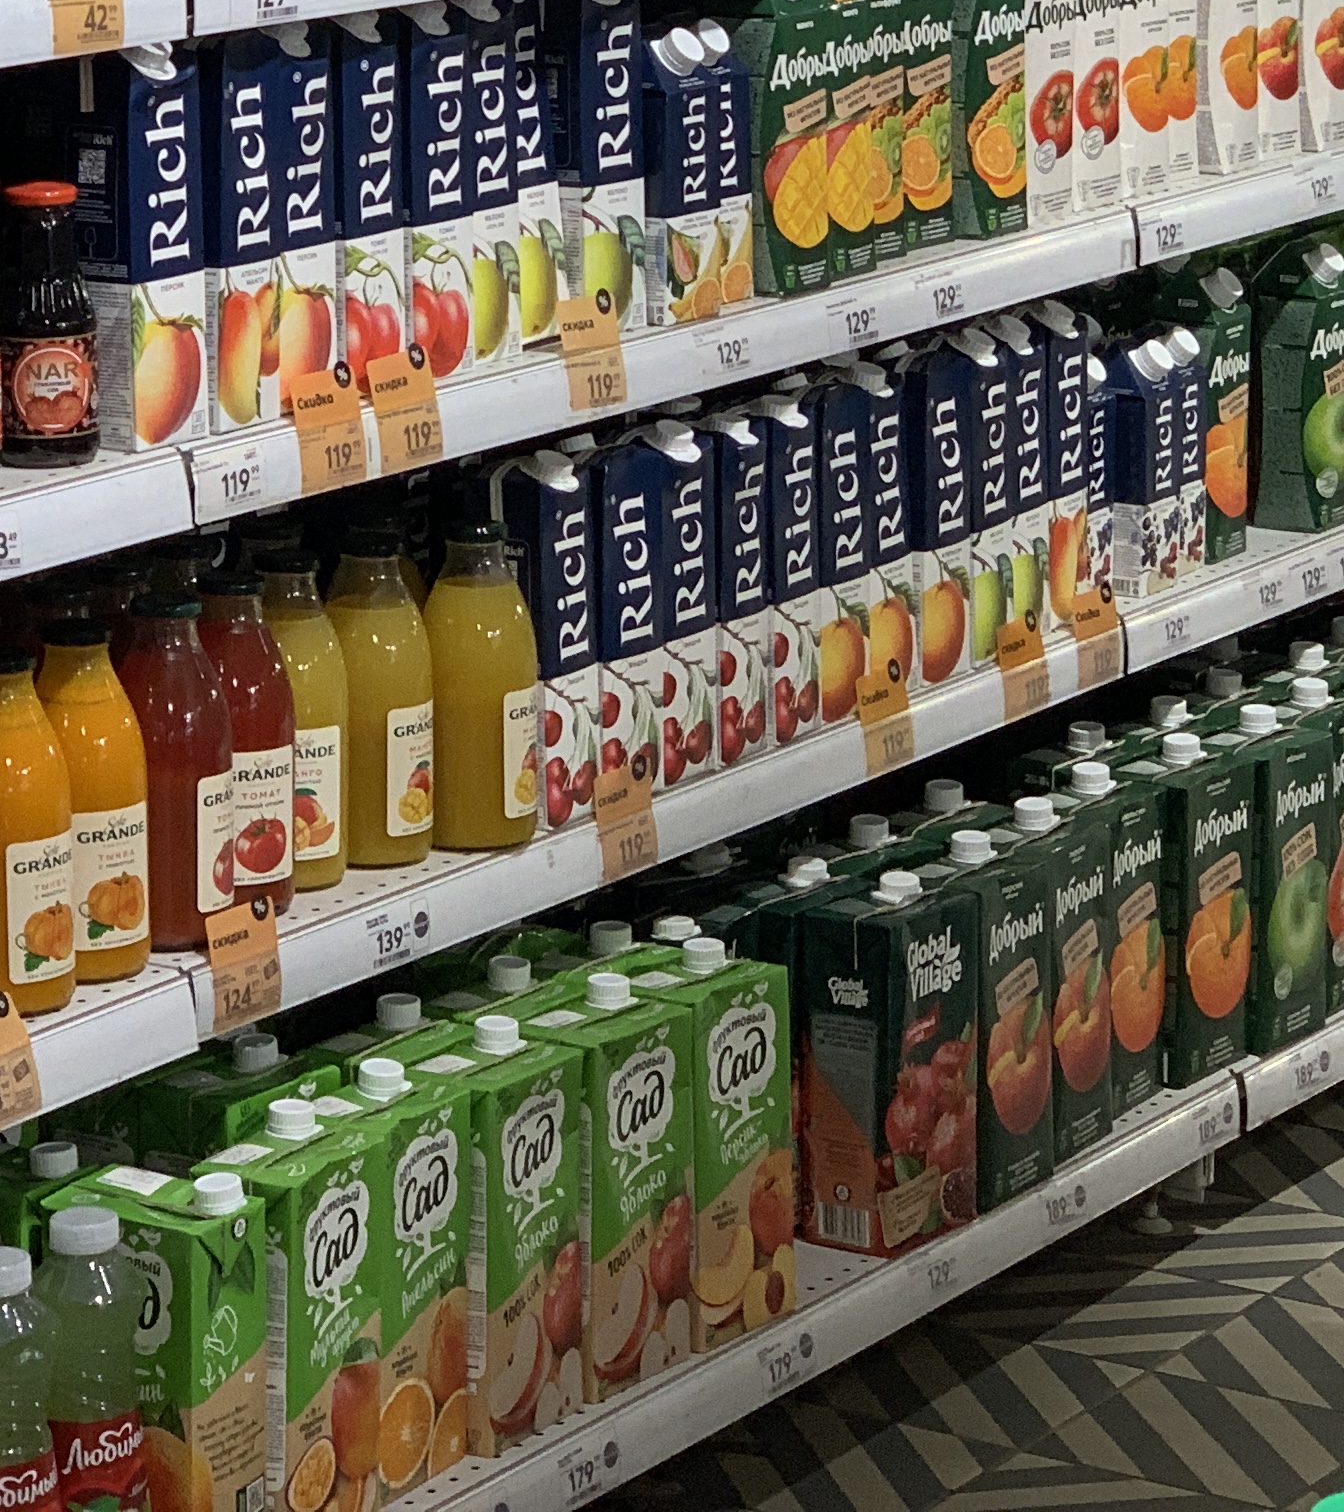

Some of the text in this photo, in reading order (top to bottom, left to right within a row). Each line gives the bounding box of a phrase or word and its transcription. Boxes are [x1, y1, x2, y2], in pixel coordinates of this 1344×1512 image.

[597, 20, 634, 172] Rich
[230, 82, 270, 252] Rich
[287, 71, 329, 237] Rich
[146, 93, 190, 267] Rich
[845, 311, 870, 334] 129
[27, 361, 79, 382] NAR
[297, 392, 334, 411] Скидка
[325, 443, 353, 469] 119
[933, 396, 965, 536] Rich
[221, 471, 250, 498] 119
[555, 506, 590, 663] Rich
[613, 493, 653, 646] Rich
[241, 788, 283, 801] ТОМАТ
[76, 821, 146, 844] GRANDE
[1194, 800, 1249, 857] Добрый
[97, 848, 136, 861] ТЫКВА
[377, 926, 404, 953] 139
[907, 924, 957, 973] Global
[910, 955, 963, 1002] Village
[616, 1069, 665, 1144] Сад
[567, 1462, 594, 1491] 179
